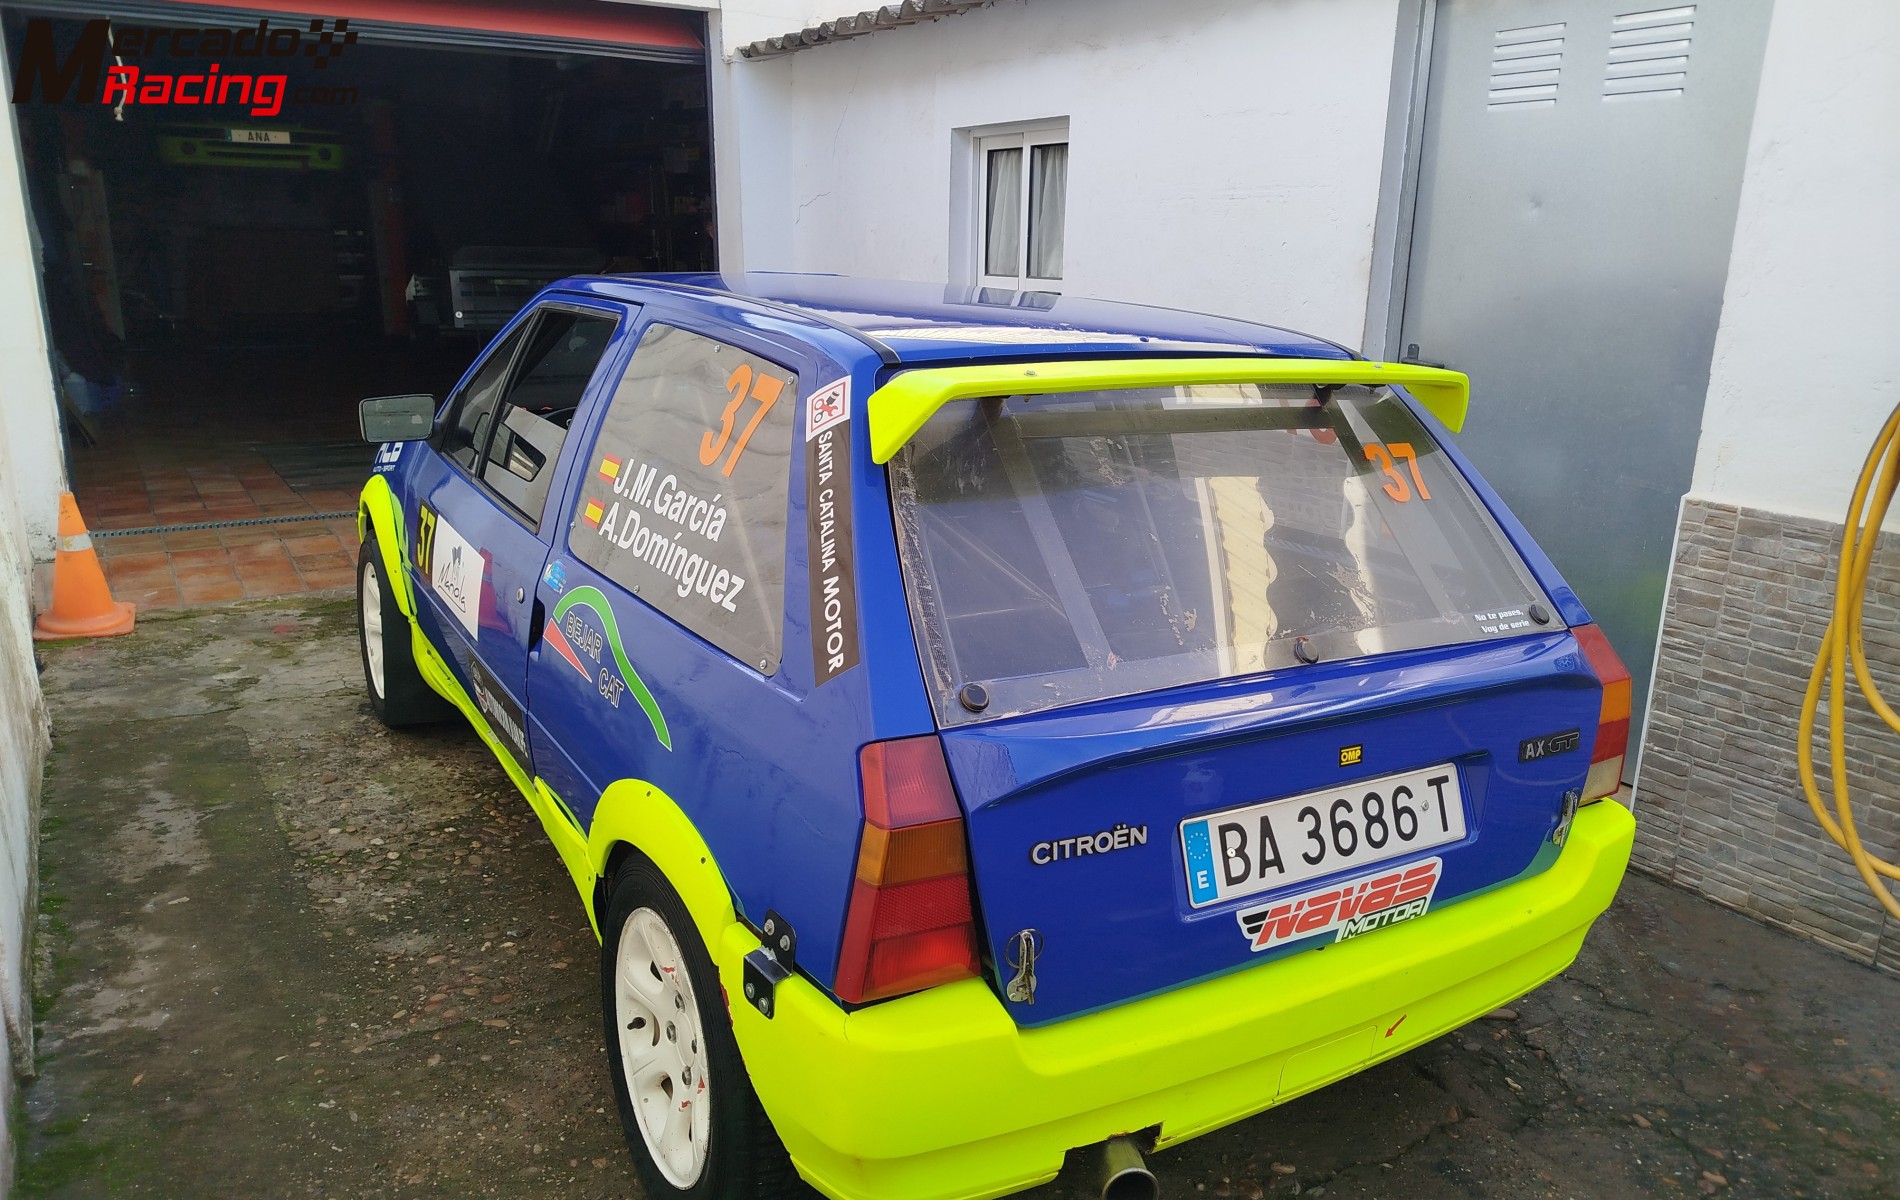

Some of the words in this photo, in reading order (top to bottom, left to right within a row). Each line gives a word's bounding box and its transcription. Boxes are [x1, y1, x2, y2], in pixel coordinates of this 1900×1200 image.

[247, 132, 271, 143] ANA
[699, 364, 785, 478] 37
[818, 430, 833, 486] SANTA
[1363, 442, 1432, 503] 37
[613, 458, 727, 542] J.M.García
[417, 504, 436, 575] 37
[819, 488, 836, 573] CATALINA
[598, 502, 746, 613] A.Domínguez
[565, 611, 603, 664] BEJAR
[823, 575, 844, 674] MOTOR
[1474, 614, 1487, 622] No
[1488, 612, 1498, 620] te
[1481, 624, 1498, 634] Voy
[1499, 622, 1510, 631] de
[1510, 619, 1531, 629] serie
[598, 667, 624, 708] CAT
[1340, 749, 1361, 763] OMP
[1525, 740, 1545, 760] AX
[1549, 731, 1580, 753] GT
[1031, 823, 1148, 865] CITROËN
[1218, 815, 1286, 887] BA
[1297, 785, 1418, 866] 3686
[1426, 774, 1450, 833] T
[1196, 870, 1210, 890] E
[1343, 897, 1427, 939] MOTOR
